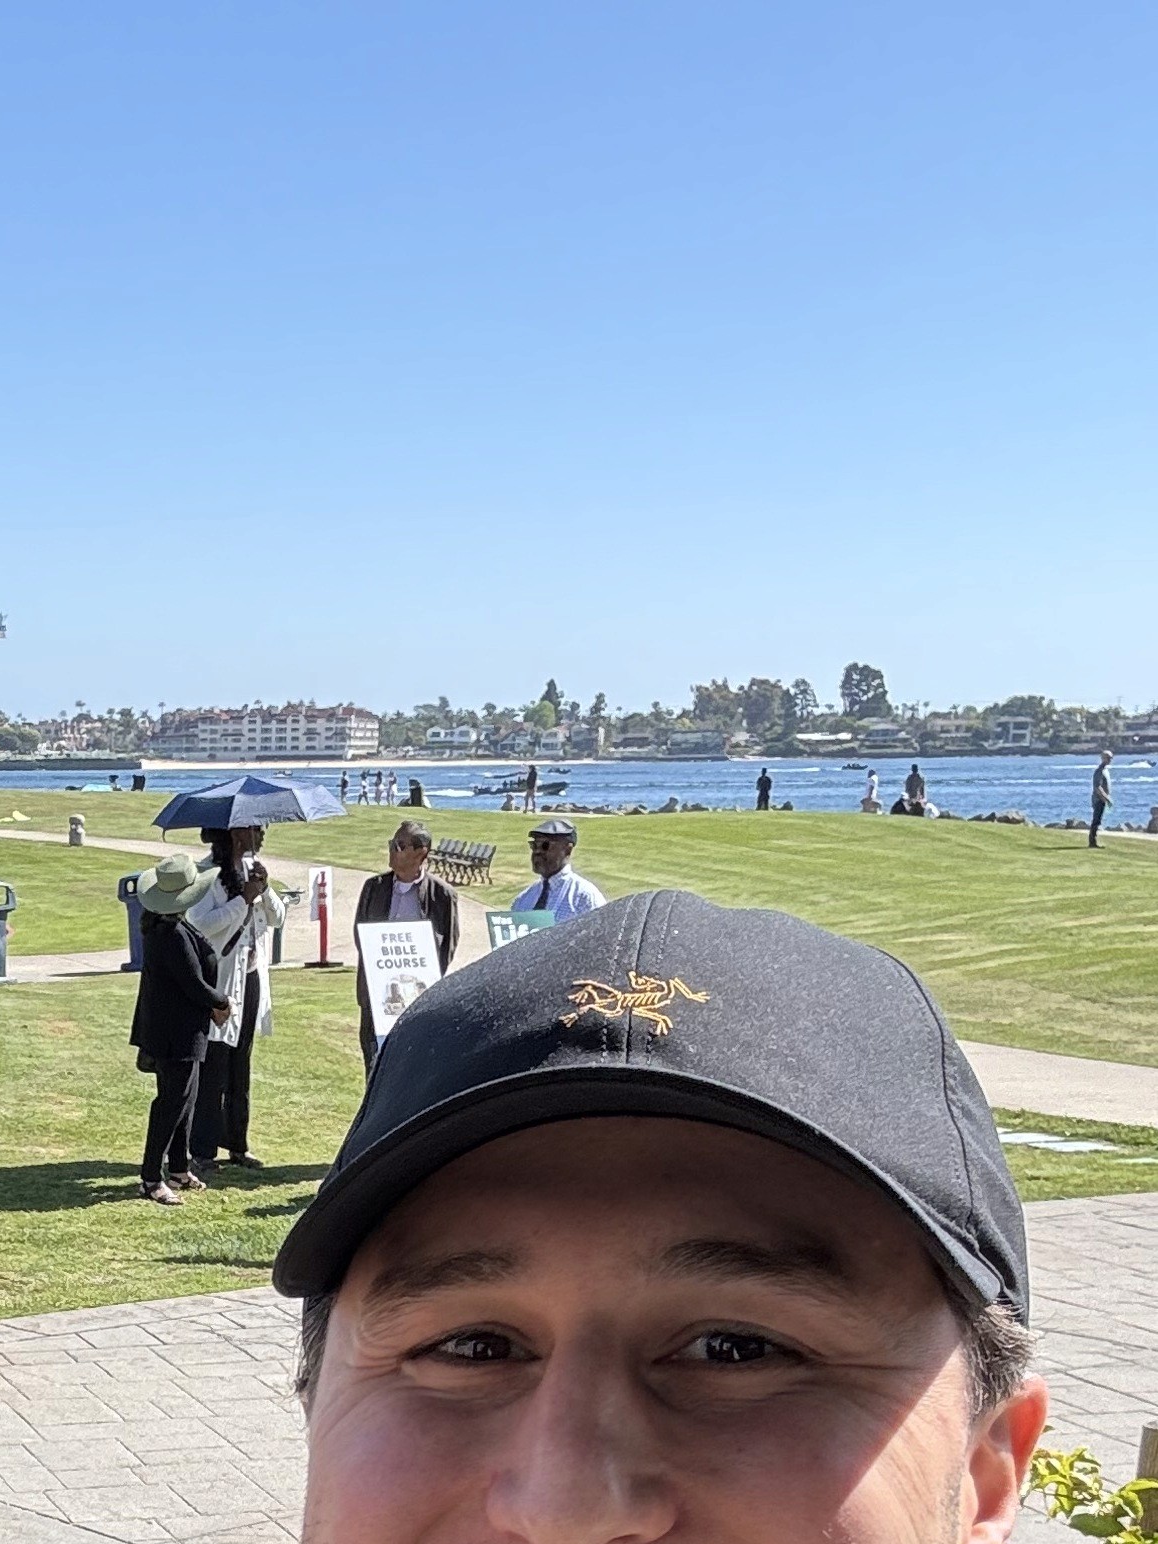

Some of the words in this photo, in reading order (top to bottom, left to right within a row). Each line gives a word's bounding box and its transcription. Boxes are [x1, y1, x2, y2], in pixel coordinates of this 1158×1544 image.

[381, 931, 413, 943] FREE
[381, 944, 418, 956] BIBLE
[376, 957, 428, 969] COURSE
